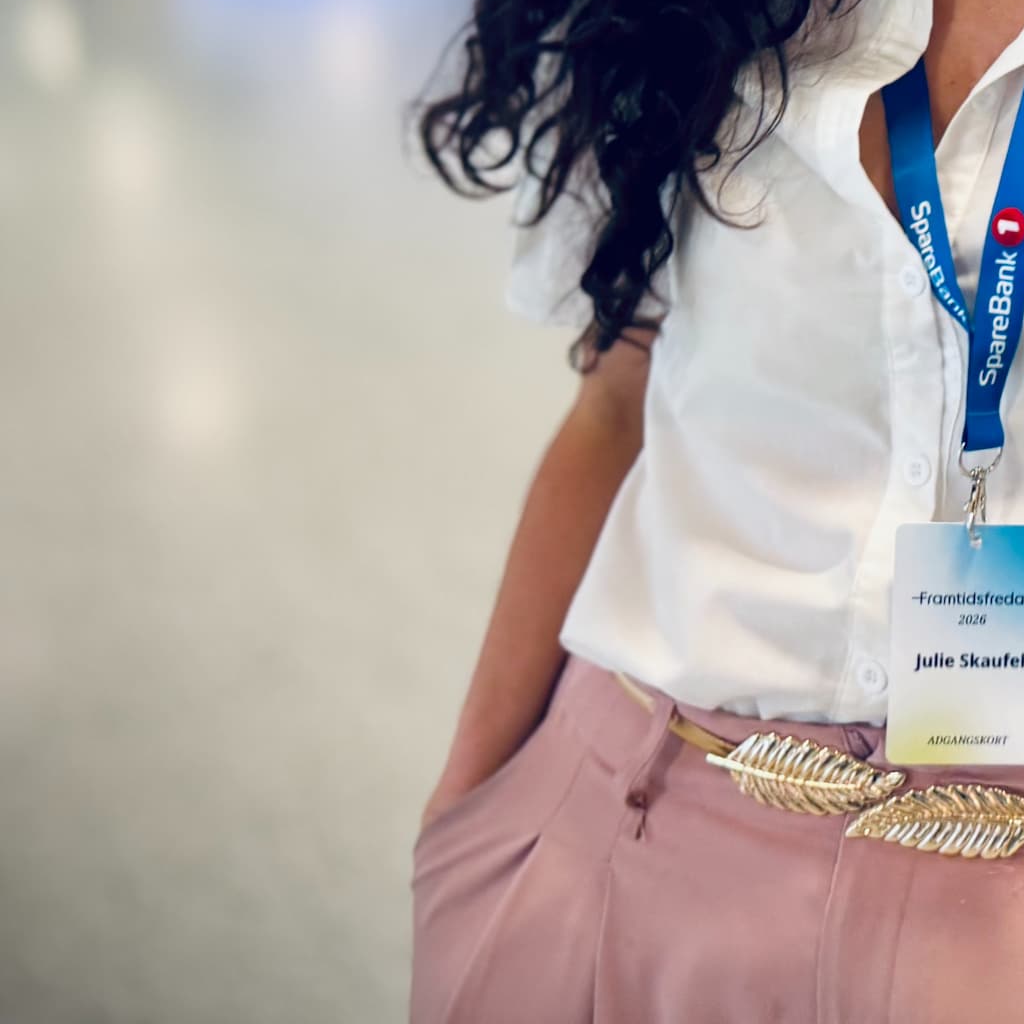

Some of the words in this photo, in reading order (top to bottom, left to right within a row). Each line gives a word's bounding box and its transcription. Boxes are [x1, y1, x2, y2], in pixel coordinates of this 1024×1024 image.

[979, 251, 1018, 386] SpareBank
[958, 613, 987, 625] 2026
[914, 652, 955, 672] Julie
[927, 735, 1008, 745] ADGANGSKORT
